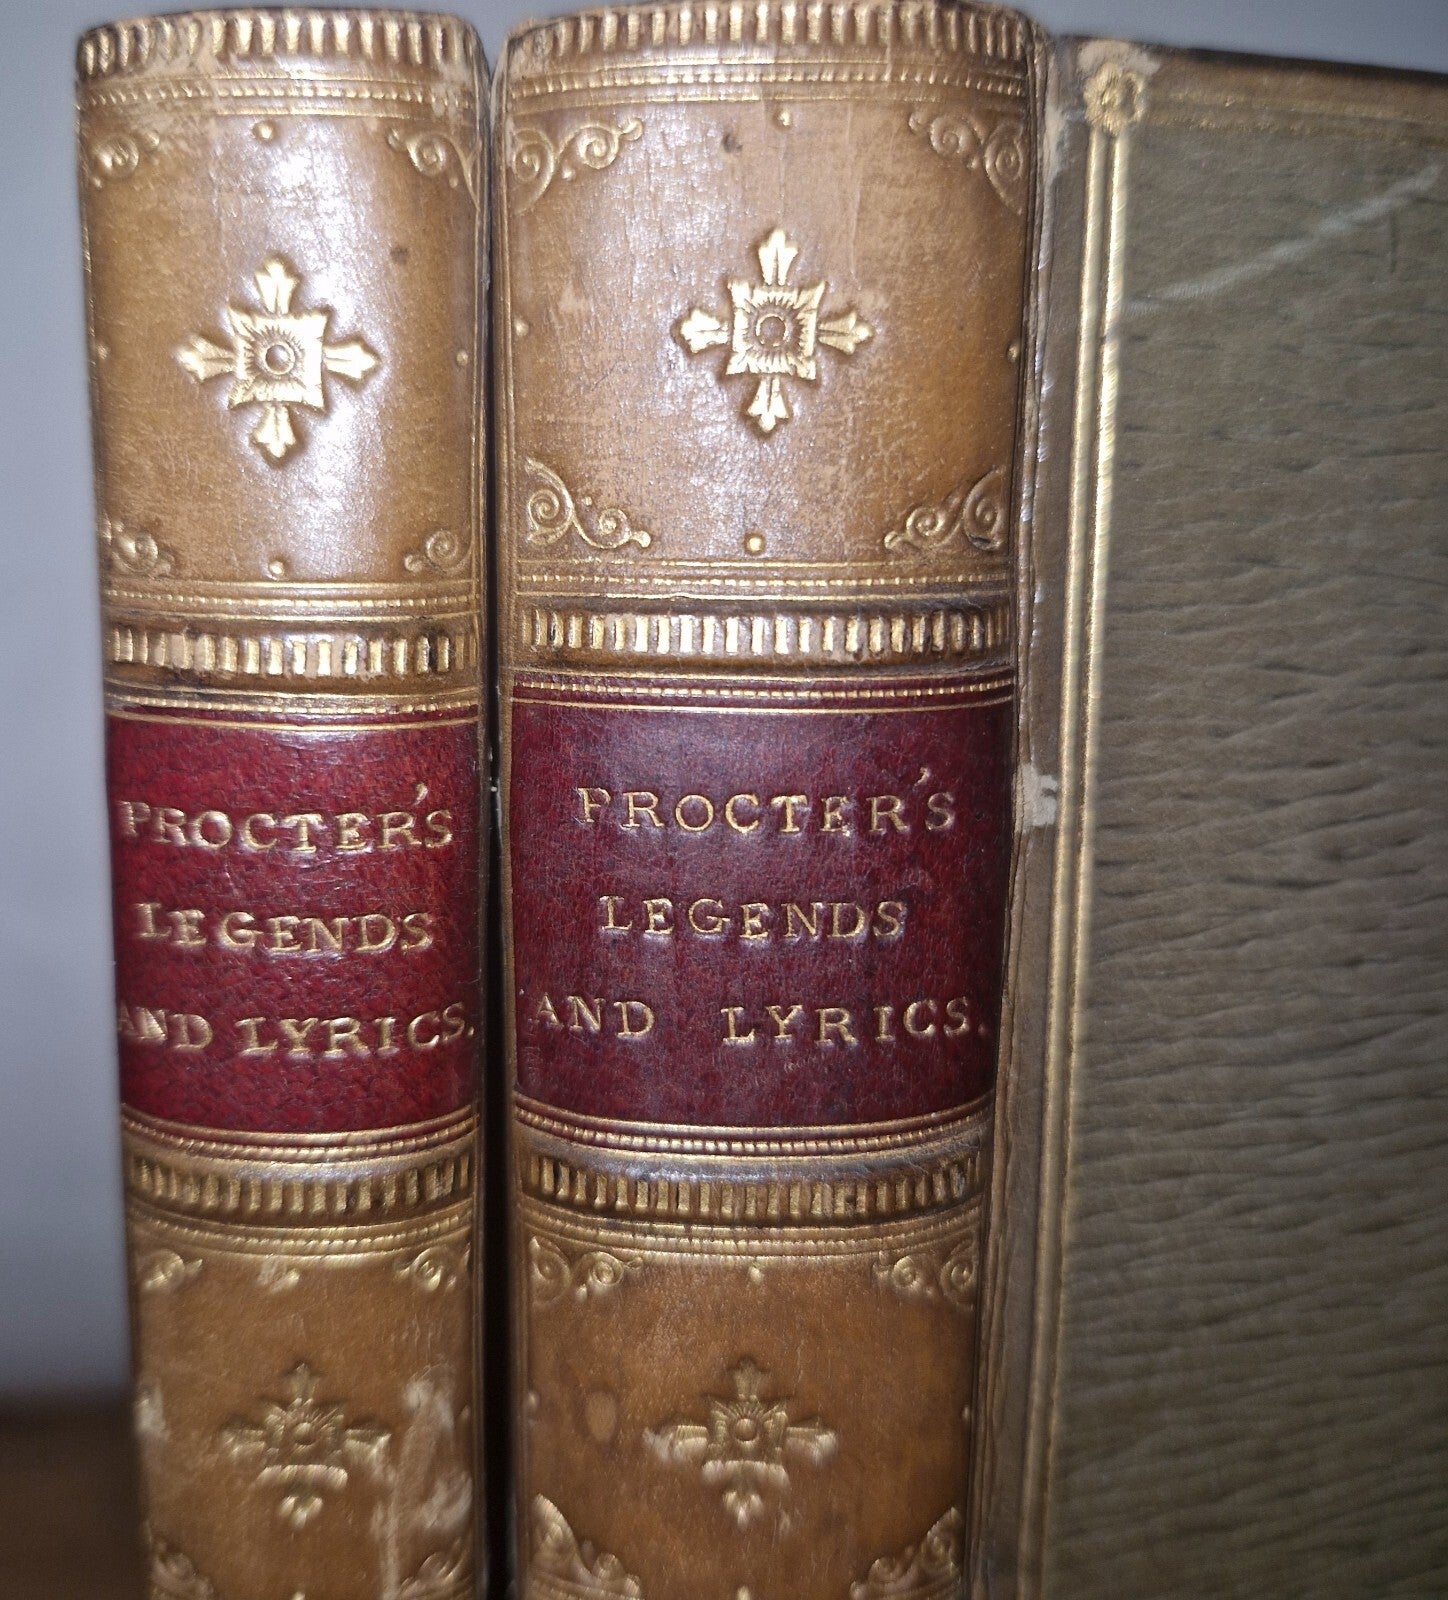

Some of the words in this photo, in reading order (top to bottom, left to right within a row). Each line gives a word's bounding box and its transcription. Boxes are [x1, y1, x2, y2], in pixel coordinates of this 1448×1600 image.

[117, 783, 454, 852] PROCTER'S
[577, 767, 955, 836] PROCTER'S
[135, 902, 434, 953] LEGENDS
[599, 895, 906, 940] LEGENDS
[117, 1001, 213, 1051] AND
[234, 1002, 475, 1059] LYRICS.
[535, 993, 656, 1039] AND
[721, 996, 986, 1045] LYRICS.
